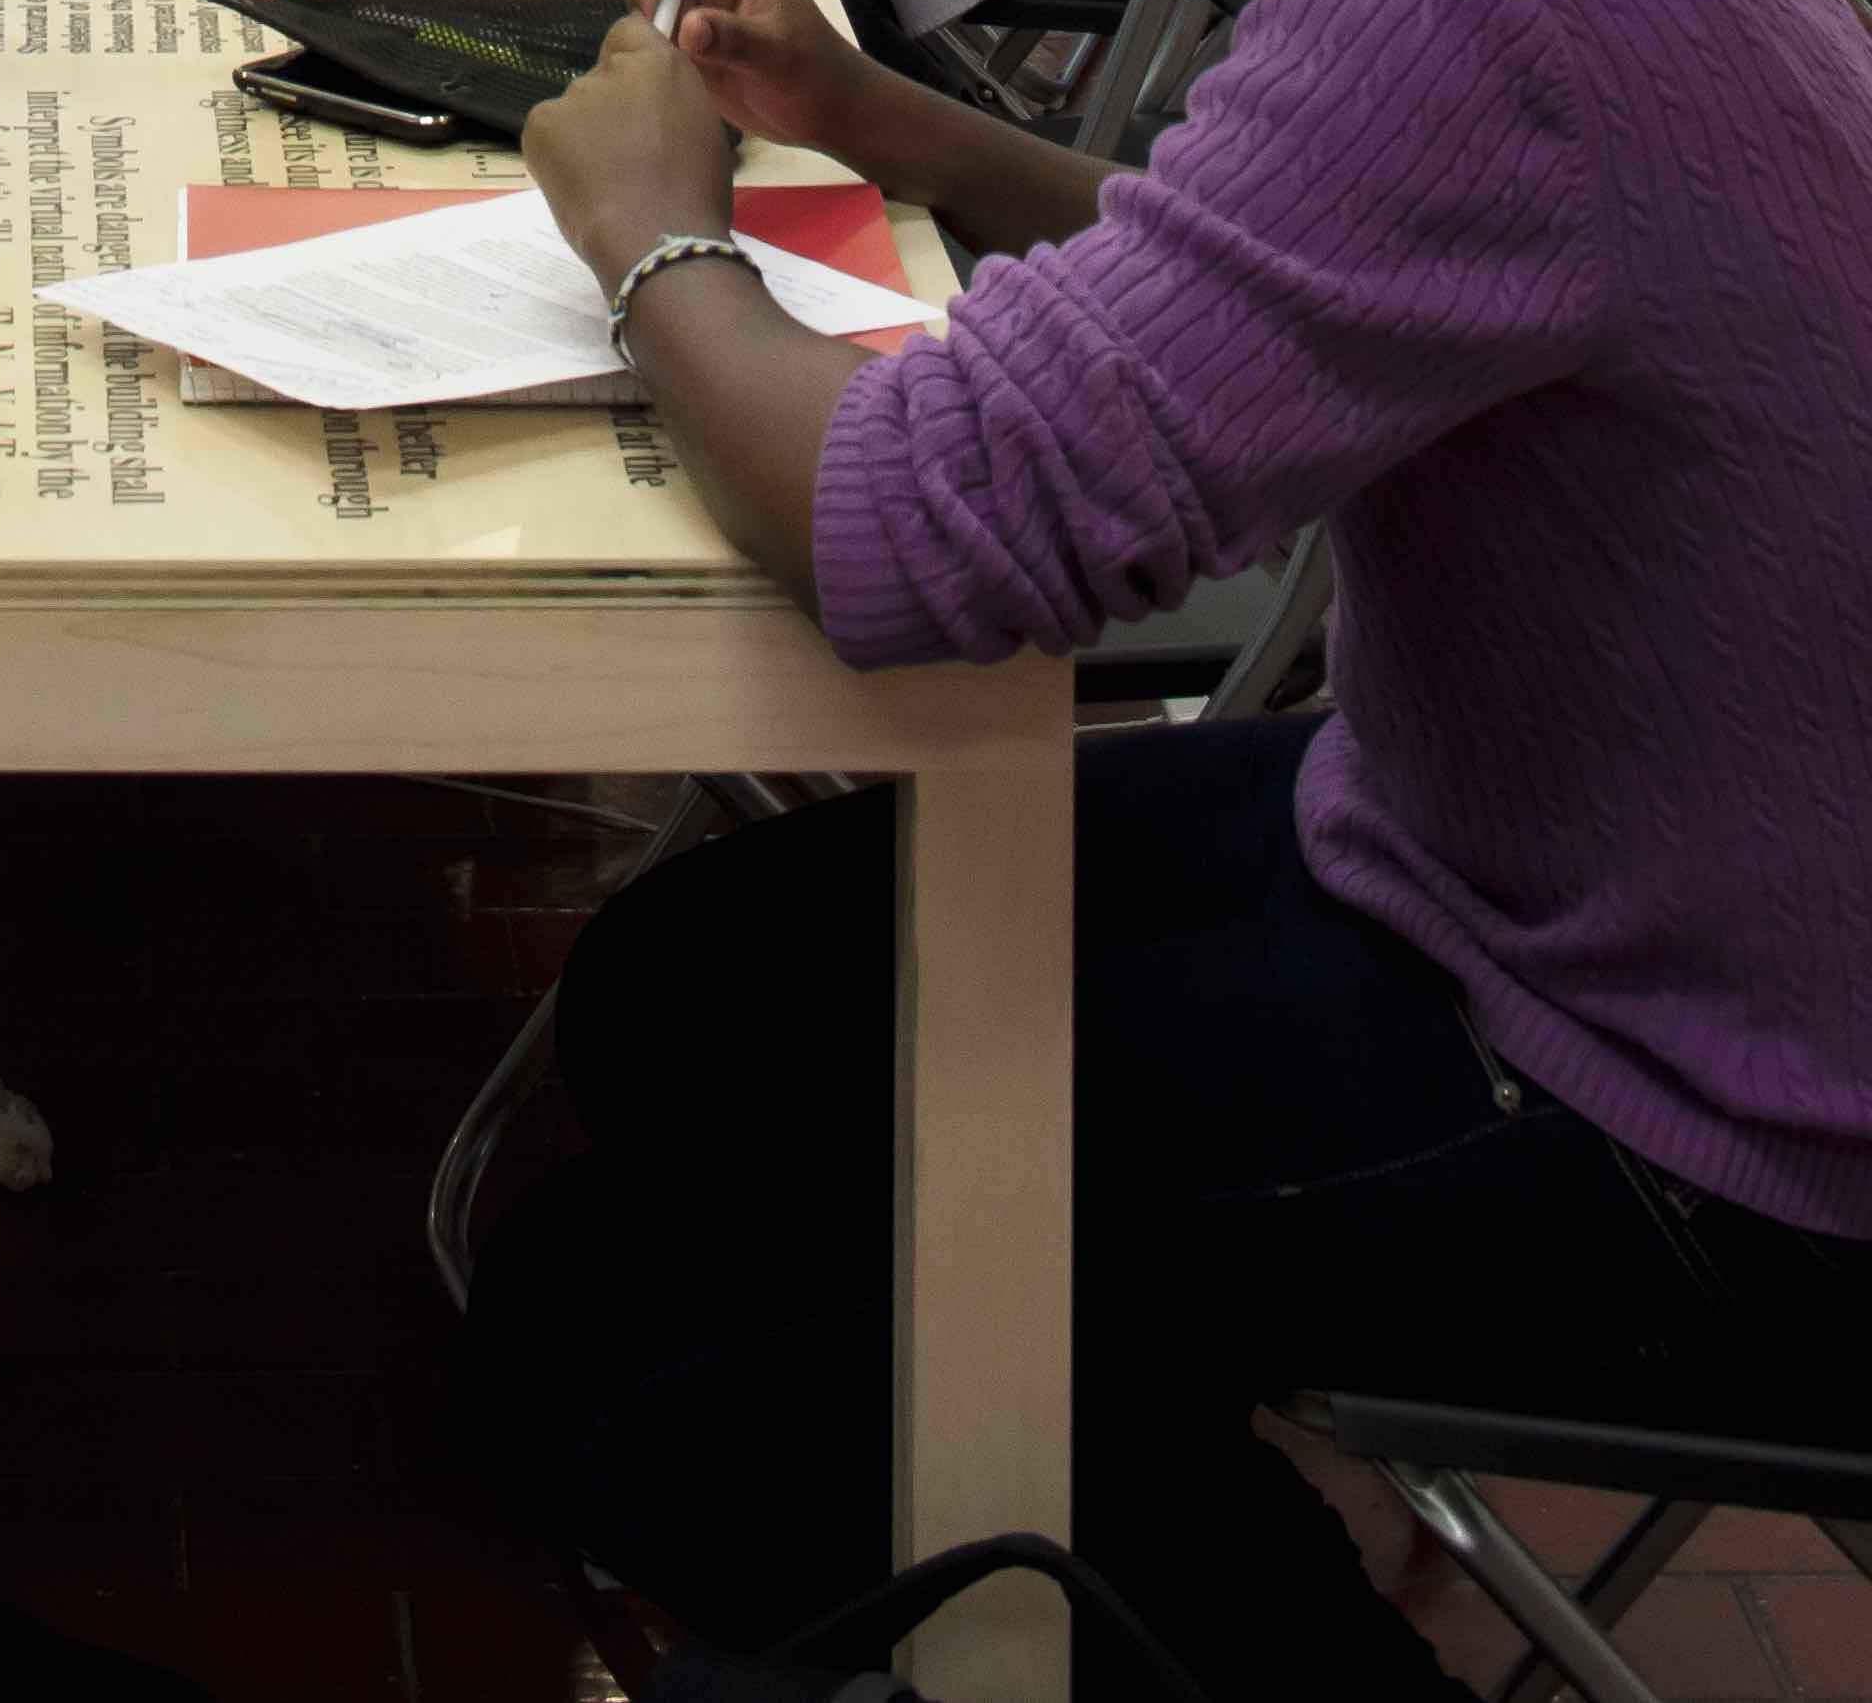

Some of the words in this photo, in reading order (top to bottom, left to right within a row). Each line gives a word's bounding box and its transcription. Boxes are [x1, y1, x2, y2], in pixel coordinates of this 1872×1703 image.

[14, 90, 69, 156] interpret
[198, 90, 265, 155] lightness
[80, 115, 138, 180] Symbols
[281, 143, 325, 163] its
[28, 160, 74, 183] the
[219, 157, 268, 186] and
[349, 165, 393, 179] is
[95, 184, 127, 209] are
[29, 186, 77, 241] virtual
[84, 212, 145, 275] danger
[31, 244, 76, 296] natu
[33, 304, 81, 322] of
[104, 342, 152, 370] the
[33, 325, 86, 434] information
[92, 373, 159, 452] building
[607, 402, 662, 427] nd
[22, 439, 87, 463] by
[392, 420, 455, 479] better
[615, 432, 665, 450] at
[37, 468, 89, 498] the
[110, 458, 163, 504] shall
[310, 439, 389, 519] through
[622, 455, 680, 488] the
